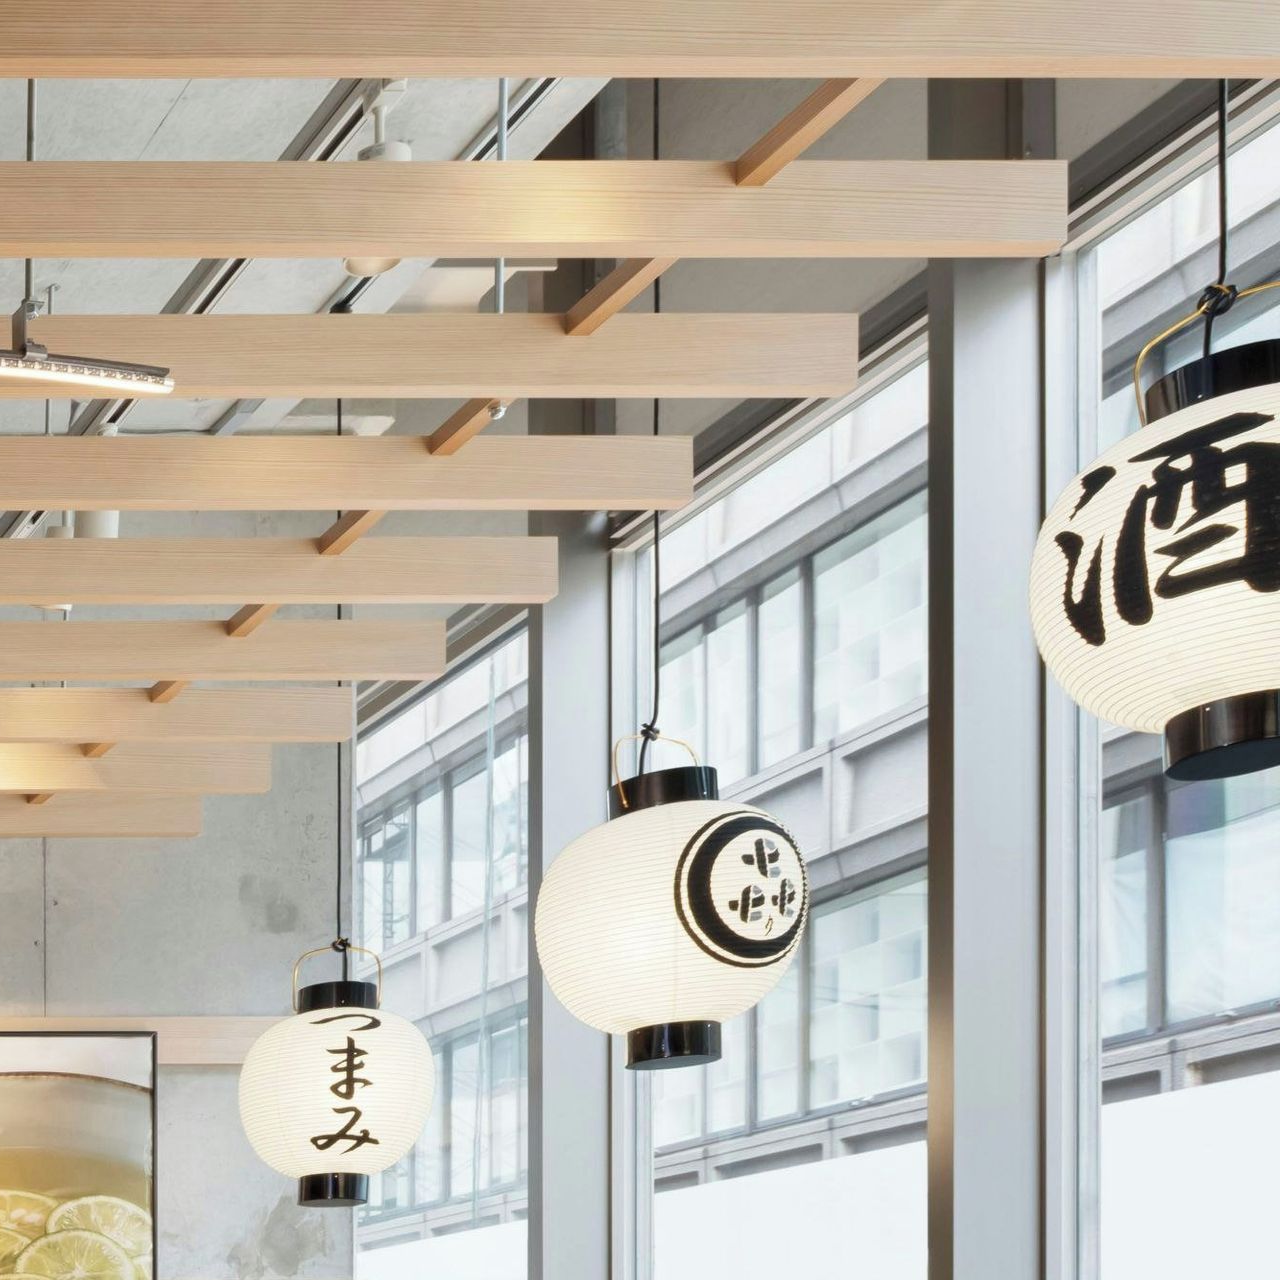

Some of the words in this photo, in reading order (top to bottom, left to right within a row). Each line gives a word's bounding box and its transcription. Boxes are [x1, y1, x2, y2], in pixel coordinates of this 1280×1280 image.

[1054, 411, 1280, 647] 酒
[309, 1013, 383, 1155] つまみ
